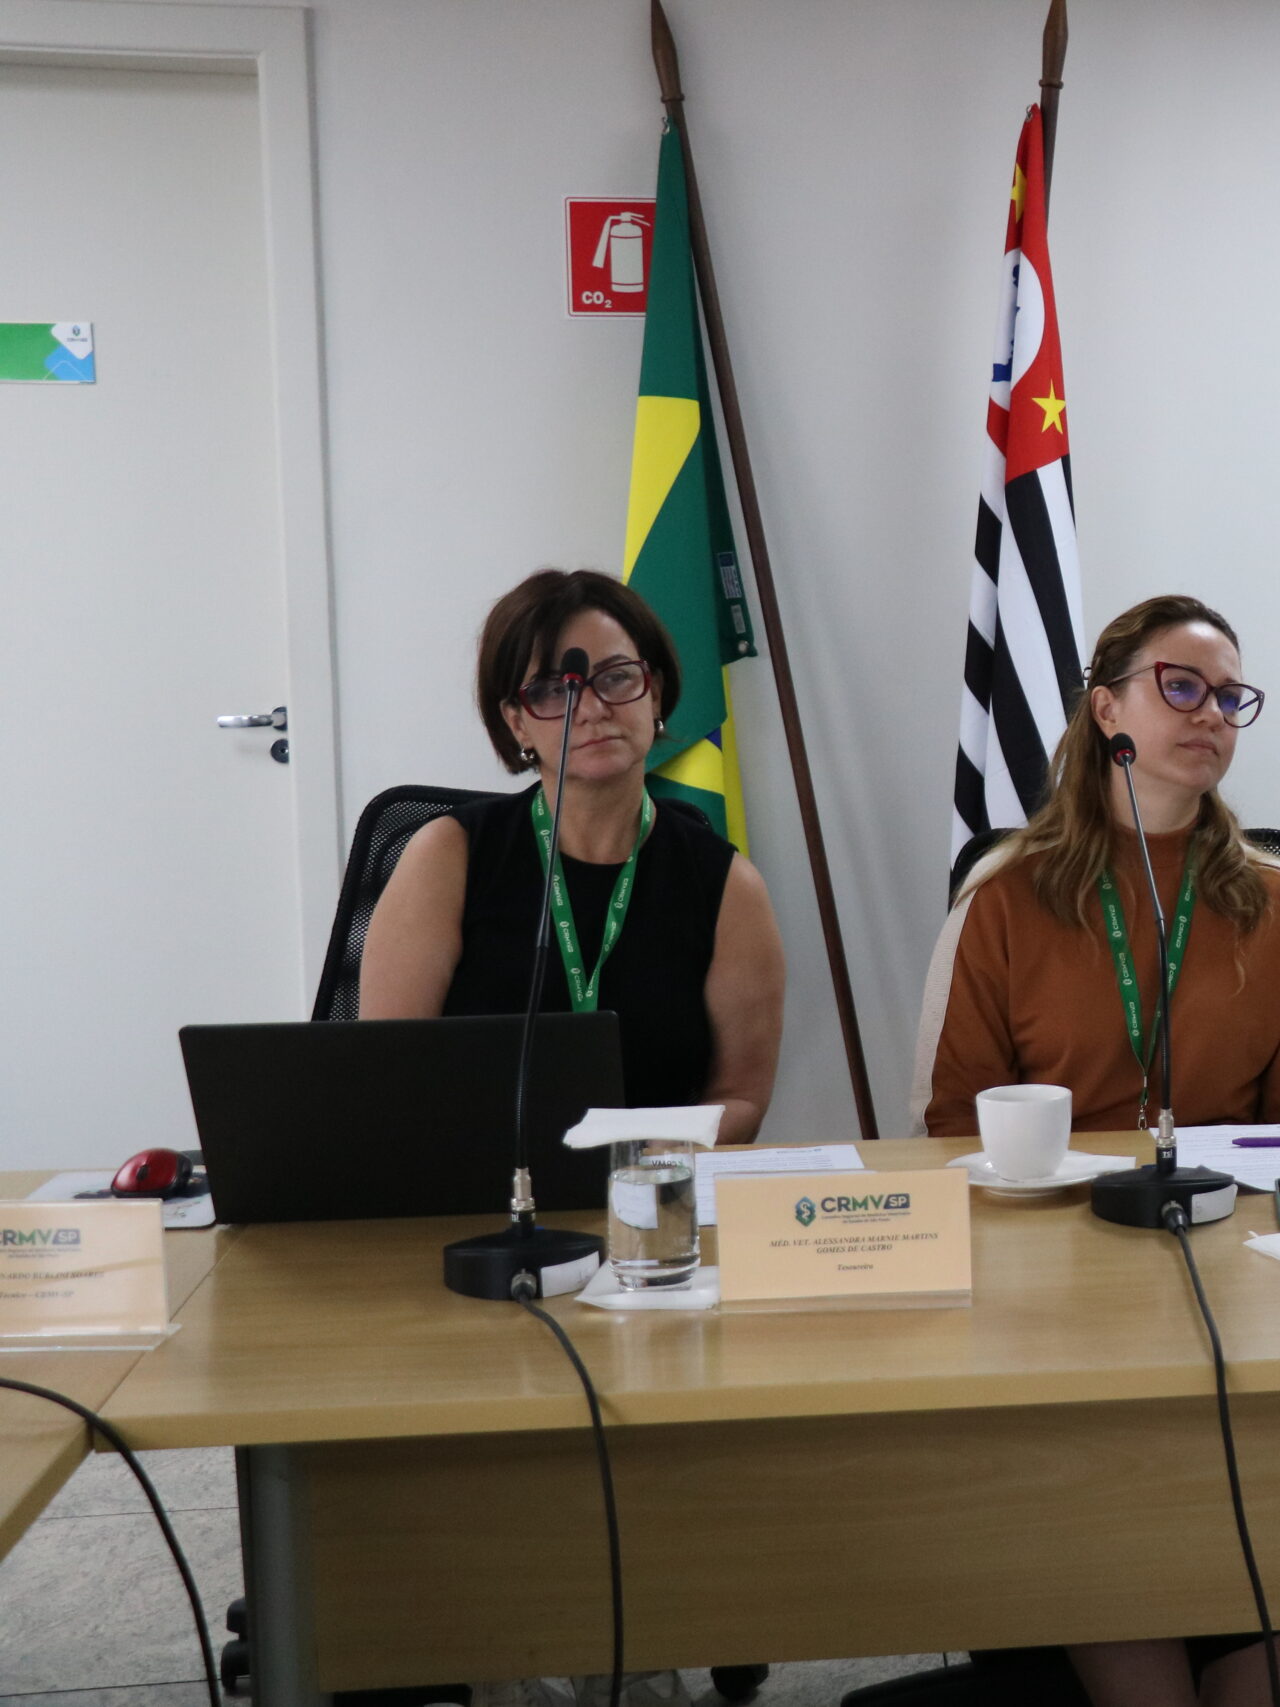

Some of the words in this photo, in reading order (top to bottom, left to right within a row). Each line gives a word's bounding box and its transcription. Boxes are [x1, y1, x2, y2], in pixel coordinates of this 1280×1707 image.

[821, 1194, 884, 1212] CRMV
[0, 1229, 52, 1246] RMV
[814, 1236, 866, 1246] ALESSANDRA
[901, 1232, 939, 1242] MARTINS
[816, 1246, 846, 1254] GOMES
[847, 1245, 858, 1253] DE
[860, 1244, 893, 1252] CASTRO
